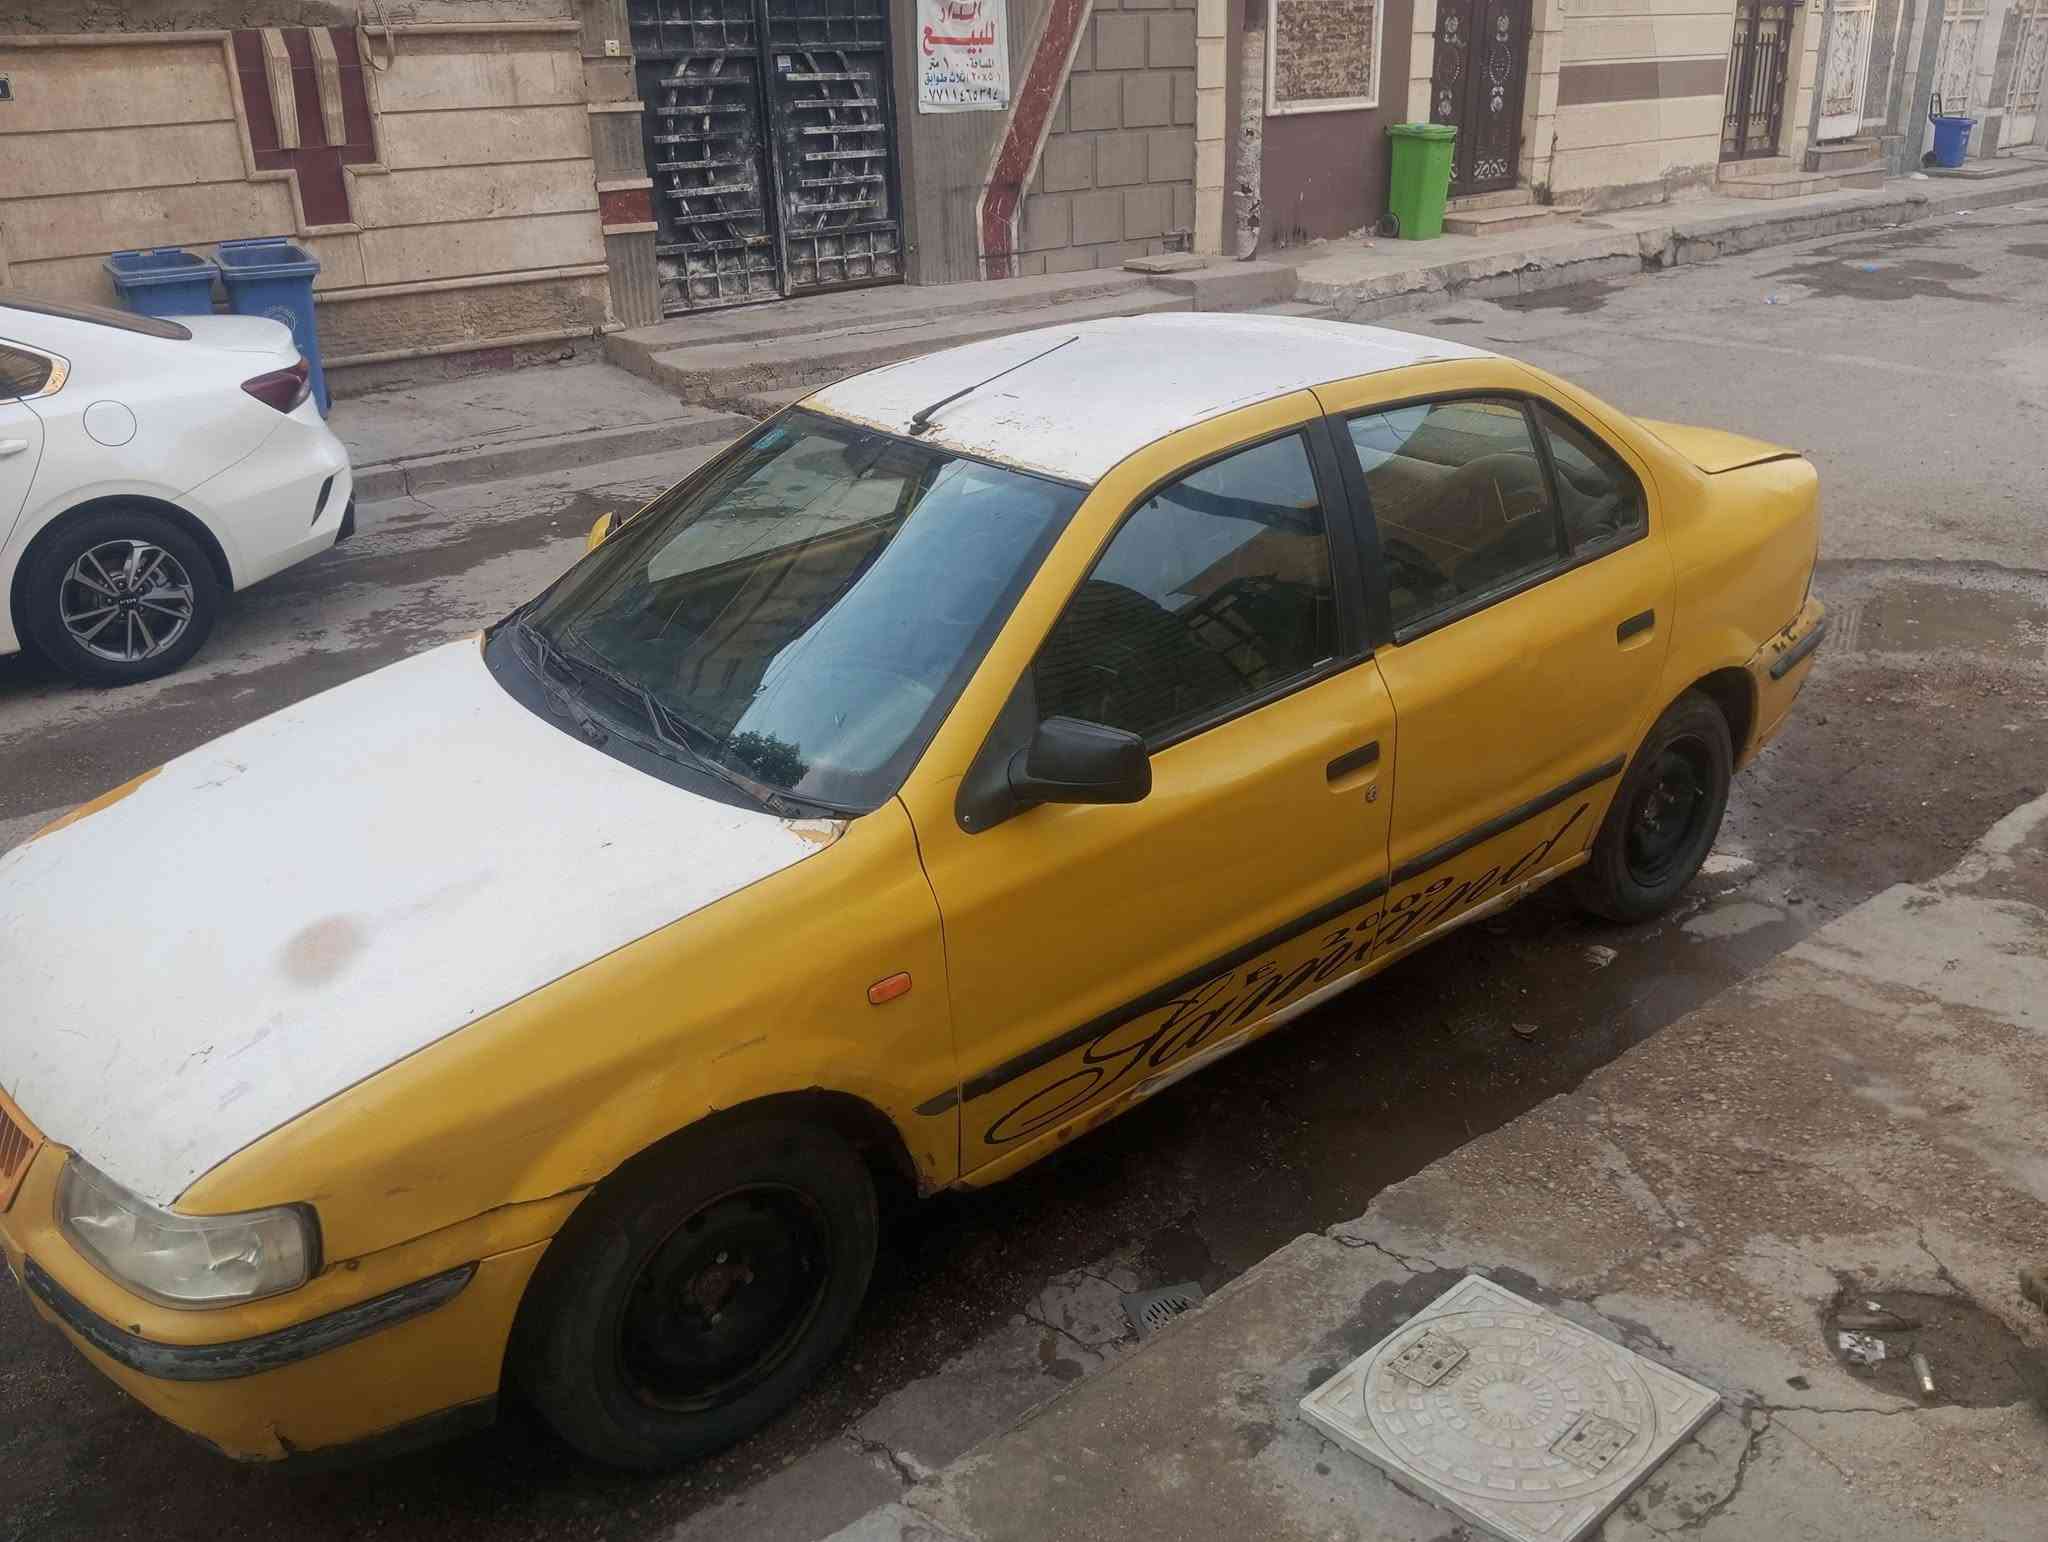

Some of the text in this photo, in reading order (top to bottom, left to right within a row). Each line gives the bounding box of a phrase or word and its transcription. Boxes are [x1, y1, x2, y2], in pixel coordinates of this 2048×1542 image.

[922, 20, 995, 56] للبيع
[1321, 876, 1454, 950] 2009
[984, 802, 1590, 1145] Samand
